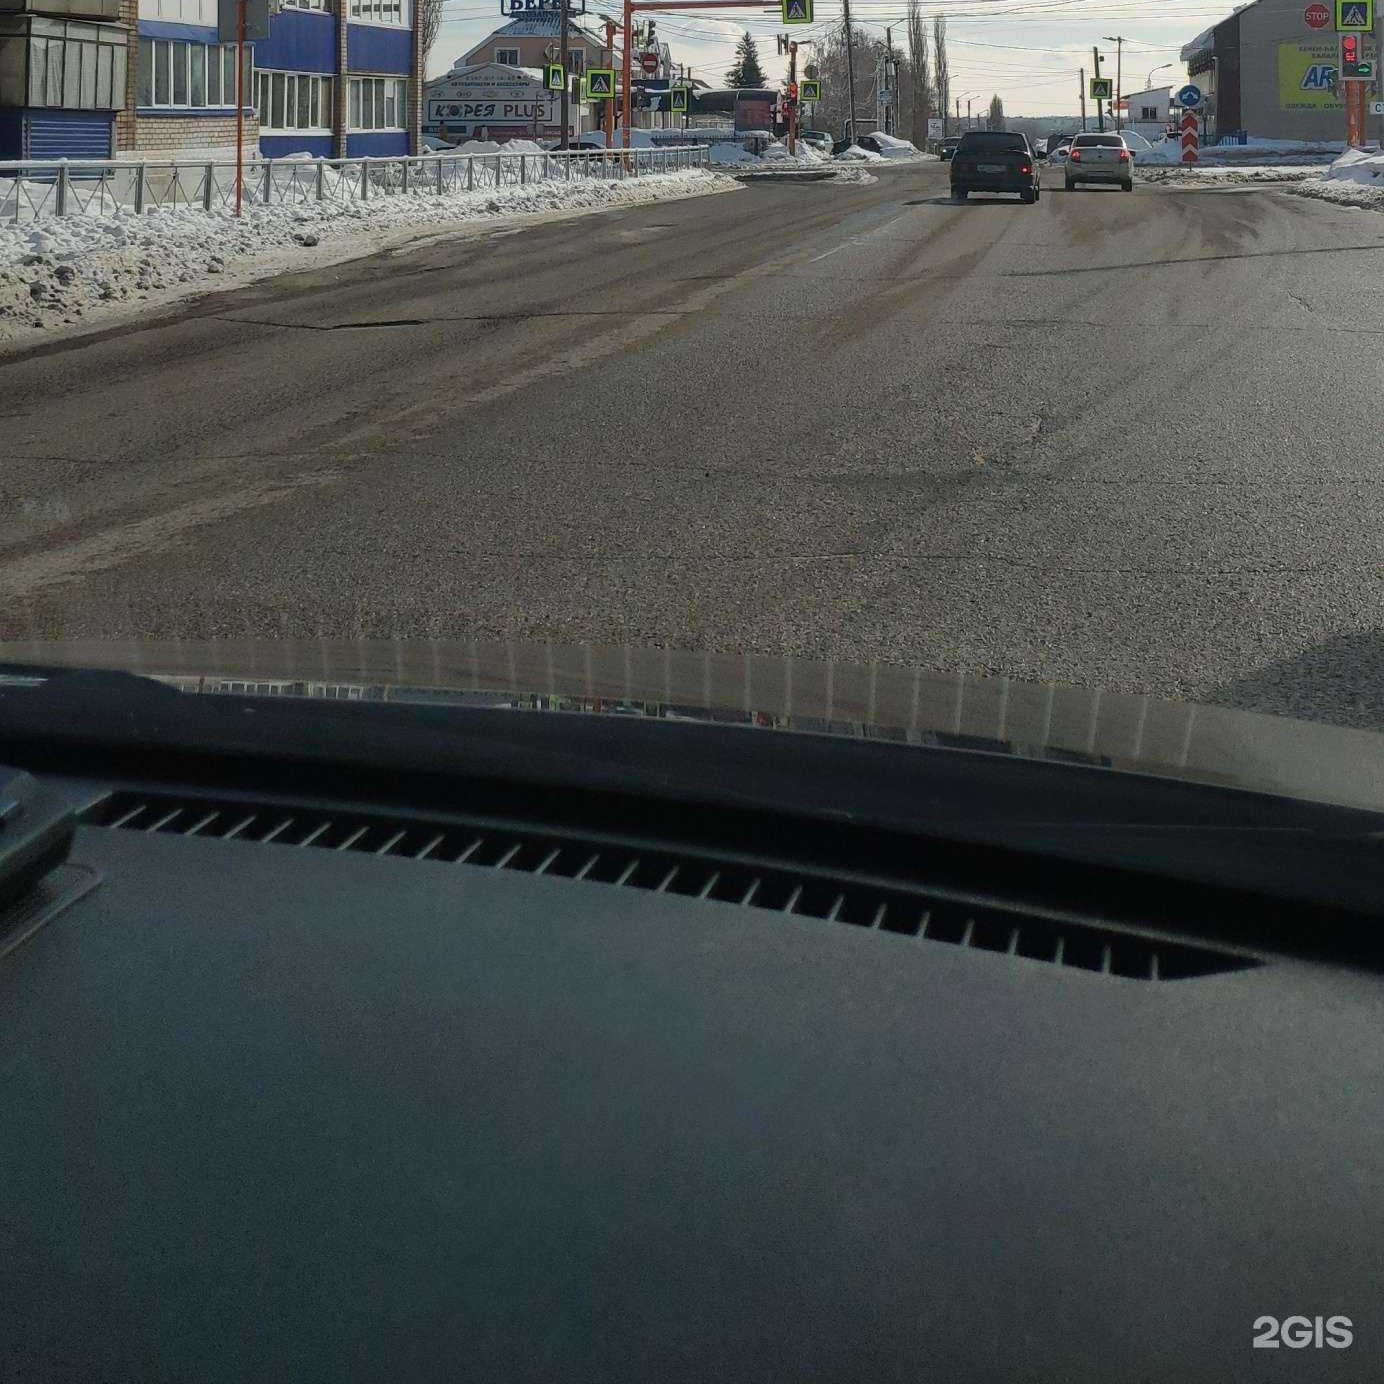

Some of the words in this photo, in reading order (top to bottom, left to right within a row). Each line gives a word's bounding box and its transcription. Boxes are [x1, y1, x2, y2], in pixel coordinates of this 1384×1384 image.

[1306, 12, 1329, 20] STOP
[435, 103, 496, 117] КОРЕЯ
[504, 103, 545, 117] PLUS
